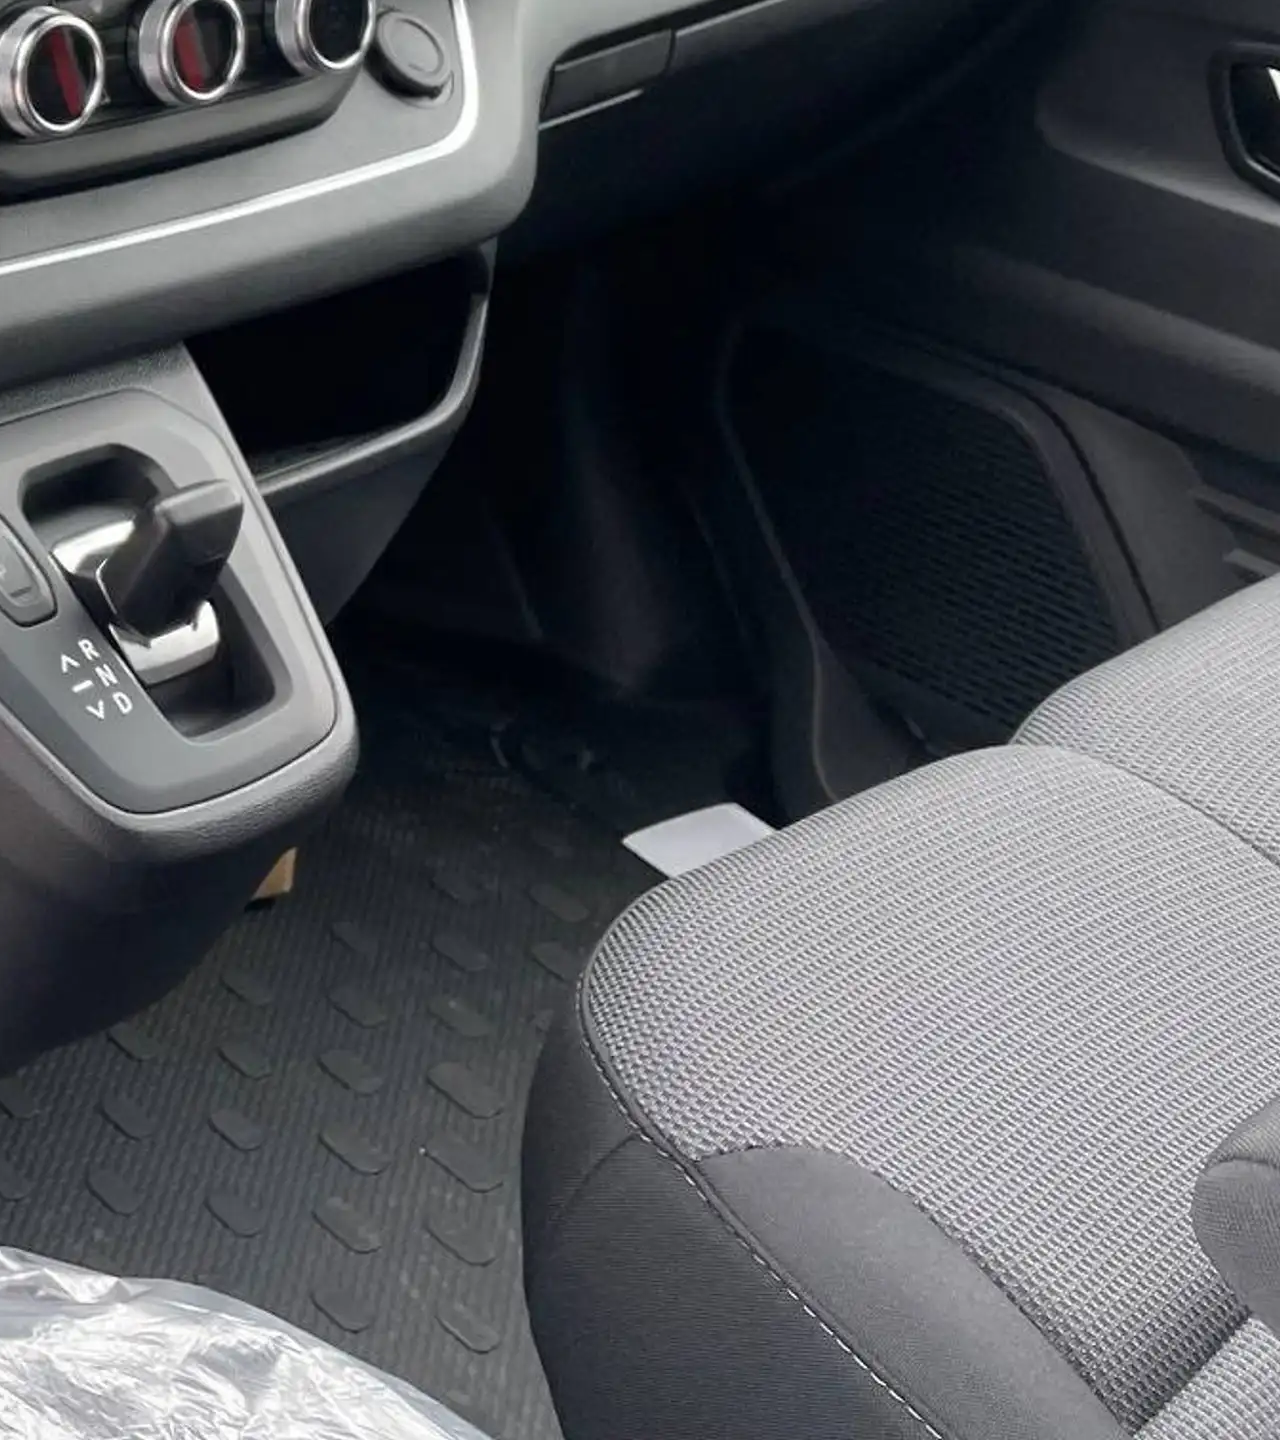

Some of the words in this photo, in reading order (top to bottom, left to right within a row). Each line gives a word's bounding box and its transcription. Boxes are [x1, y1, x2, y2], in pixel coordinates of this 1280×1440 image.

[77, 639, 100, 663] R
[95, 664, 118, 687] N
[113, 691, 134, 716] D
